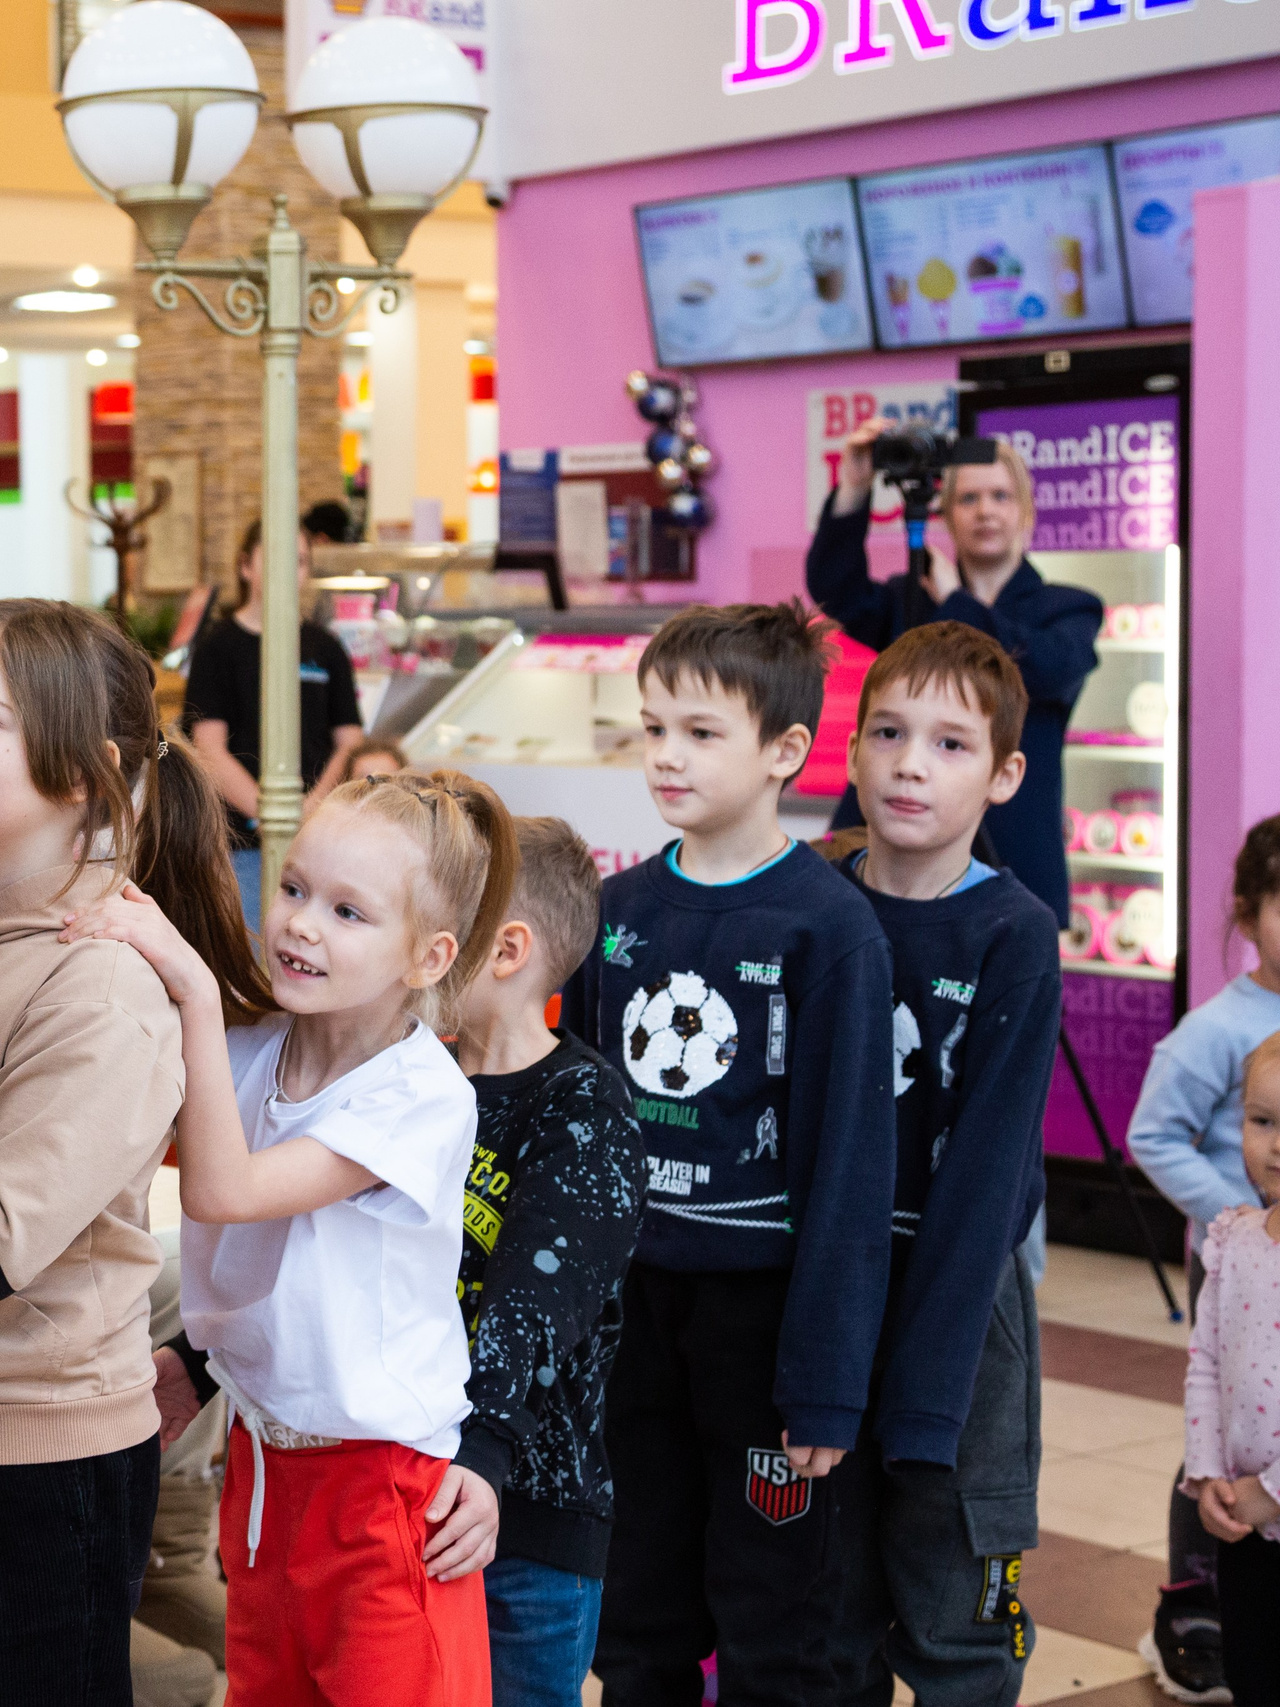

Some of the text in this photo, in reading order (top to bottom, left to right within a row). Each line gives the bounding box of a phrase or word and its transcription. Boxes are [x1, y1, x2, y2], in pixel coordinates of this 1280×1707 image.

[992, 421, 1175, 469] RandICE
[739, 970, 780, 986] ATTACK
[646, 1155, 711, 1184] PLAYER IN
[648, 1173, 693, 1196] SEASON
[753, 1453, 799, 1486] US
